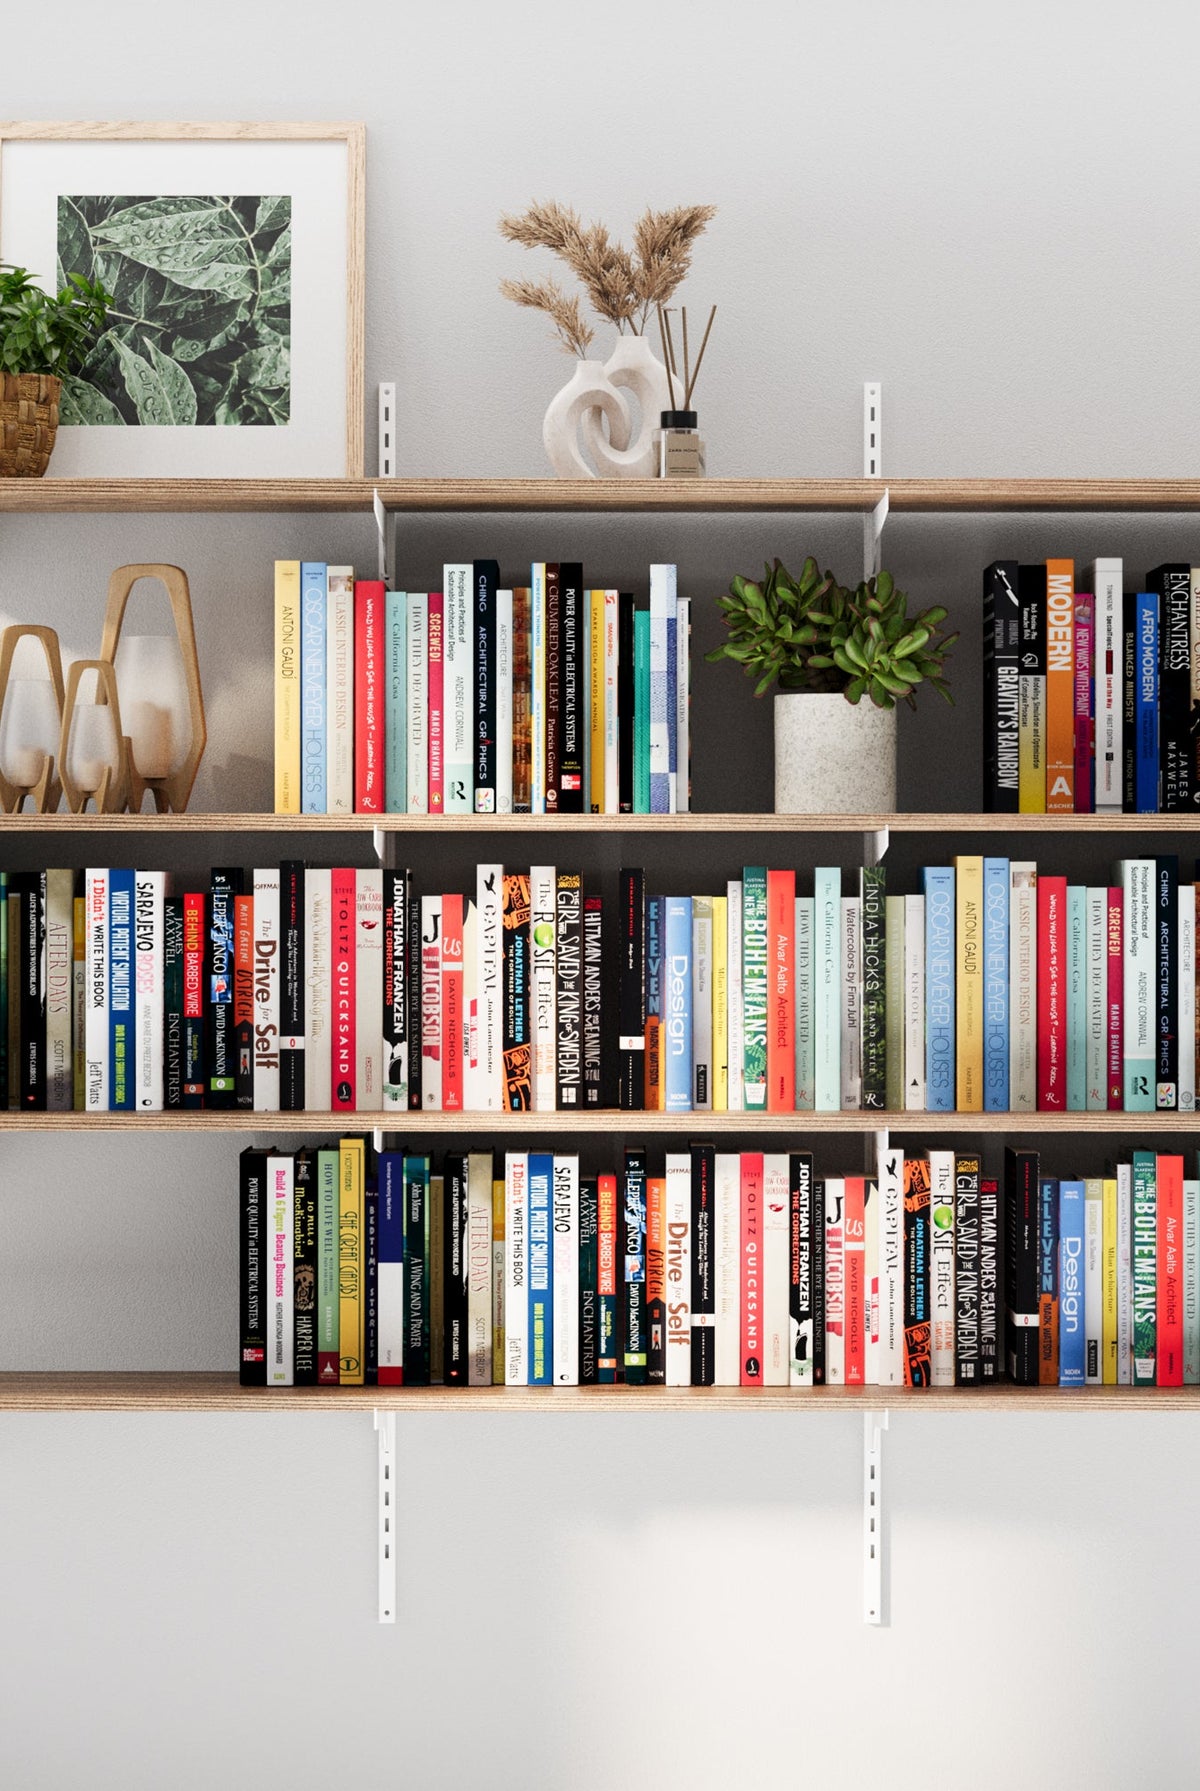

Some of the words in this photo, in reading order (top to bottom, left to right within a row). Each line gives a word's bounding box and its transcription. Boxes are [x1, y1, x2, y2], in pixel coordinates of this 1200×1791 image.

[458, 571, 466, 596] Principles
[479, 576, 487, 612] CHING
[565, 589, 575, 615] POWER
[305, 588, 322, 645] OSCAR
[336, 595, 345, 637] CLASSIC
[412, 606, 421, 631] HOW
[458, 598, 466, 609] and
[549, 586, 558, 651] CRUMBLED
[1170, 574, 1189, 670] ENCHANTRESS
[282, 606, 293, 644] ANTONI
[458, 611, 466, 634] Practices
[564, 618, 575, 653] QUALITY
[1048, 575, 1071, 671] MODERN
[1076, 629, 1088, 647] NEW
[1142, 609, 1154, 643] AFRO
[282, 647, 296, 679] GAUDÍ
[336, 639, 345, 686] INTERIOR
[412, 638, 422, 668] THEY
[447, 641, 455, 662] Design
[479, 626, 487, 714] ARCHITECTURAL
[549, 653, 558, 679] OAK
[1076, 648, 1088, 670] WAYS
[1126, 632, 1134, 677] BALANCED
[305, 648, 322, 727] NIEMEYER
[455, 676, 464, 708] ANDREW
[566, 663, 575, 713] ELECTRICAL
[1076, 671, 1088, 691] WITH
[1142, 647, 1154, 702] MODERN
[336, 689, 346, 729] DESIGN
[412, 673, 422, 745] DECORATED
[549, 682, 558, 711] LEAF
[998, 666, 1018, 728] GRAVITY'S
[1076, 693, 1089, 716] PAINT
[1126, 681, 1134, 723] MINISTRY
[455, 711, 464, 751] CORNWALL
[566, 715, 575, 752] SYSTEMS
[306, 730, 322, 793] HOUSES
[479, 721, 493, 779] GRAPHICS
[998, 732, 1018, 788] RAINBOW
[94, 886, 104, 921] Didn't
[112, 891, 129, 925] VIRTUAL
[137, 883, 154, 951] SARAJEVO
[213, 894, 228, 928] LEPER
[394, 878, 403, 956] JONATHAN
[866, 883, 878, 932] INDIA
[965, 901, 976, 939] ANTONI
[94, 925, 104, 954] WRITE
[112, 928, 129, 961] PATIENT
[186, 909, 198, 950] BEHIND
[262, 920, 272, 937] The
[340, 898, 348, 954] TOLTZ
[585, 913, 600, 962] HITMAN
[847, 908, 856, 968] Watercolors
[49, 923, 67, 968] AFTER
[213, 932, 229, 973] TANGO
[484, 904, 496, 994] CAPITAL
[515, 935, 523, 993] JONATHAN
[648, 902, 660, 1014] ELEVEN
[777, 934, 787, 962] Alvar
[866, 937, 879, 990] HICKS
[965, 942, 979, 974] GAUDÍ
[94, 957, 104, 979] THIS
[112, 962, 129, 1010] SIMULATION
[137, 954, 154, 993] ROSES
[187, 952, 198, 990] BARBED
[256, 940, 277, 1002] Drive
[744, 920, 766, 1046] BOHEMIANS
[777, 965, 788, 994] Aalto
[846, 972, 855, 983] by
[49, 976, 67, 1013] DAYS
[94, 981, 104, 1008] BOOK
[187, 992, 198, 1014] WIRE
[236, 970, 253, 1017] OSTRICH
[394, 961, 403, 1033] FRANZEN
[423, 965, 440, 1045] JACOBSON
[585, 965, 600, 1010] ANDERS
[670, 955, 688, 1055] Design
[847, 986, 856, 1006] Finn
[259, 1005, 273, 1020] for
[340, 961, 348, 1073] QUICKSAND
[515, 998, 523, 1042] LETHEM
[777, 997, 788, 1048] Architect
[847, 1009, 857, 1028] Juhl
[54, 1040, 63, 1063] SCOTT
[255, 1024, 278, 1068] Self
[585, 1014, 600, 1067] MEANING
[650, 1026, 658, 1049] MARK
[1161, 1016, 1175, 1074] GRAPHICS
[54, 1065, 63, 1102] MEDBURY
[87, 1060, 102, 1077] Jeff
[650, 1052, 658, 1086] WATSON
[90, 1080, 101, 1103] Watts
[276, 1170, 285, 1190] Build
[324, 1164, 332, 1188] HOW
[411, 1183, 421, 1199] John
[324, 1190, 332, 1201] TO
[412, 1200, 420, 1222] Morano
[555, 1167, 571, 1232] SARAJEVO
[674, 1203, 683, 1219] The
[799, 1162, 809, 1238] JONATHAN
[274, 1207, 285, 1232] Figure
[294, 1187, 305, 1258] Mockingbird
[324, 1204, 332, 1226] LIVE
[471, 1205, 488, 1250] AFTER
[1166, 1217, 1176, 1243] Alvar
[274, 1234, 285, 1261] Beauty
[324, 1228, 333, 1253] WELL
[668, 1222, 689, 1282] Drive
[410, 1265, 421, 1289] WING
[471, 1256, 488, 1292] DAYS
[799, 1242, 809, 1311] FRANZEN
[1135, 1202, 1155, 1323] BOHEMIANS
[1166, 1246, 1176, 1273] Aalto
[276, 1263, 285, 1297] Business
[673, 1286, 684, 1299] for
[1063, 1237, 1081, 1332] Design
[410, 1291, 420, 1309] AND
[916, 1278, 924, 1320] LETHEM
[1166, 1276, 1176, 1325] Architect
[297, 1316, 311, 1351] HARPER
[410, 1319, 422, 1348] PRAYER
[668, 1302, 689, 1345] Self
[297, 1355, 312, 1371] LEE
